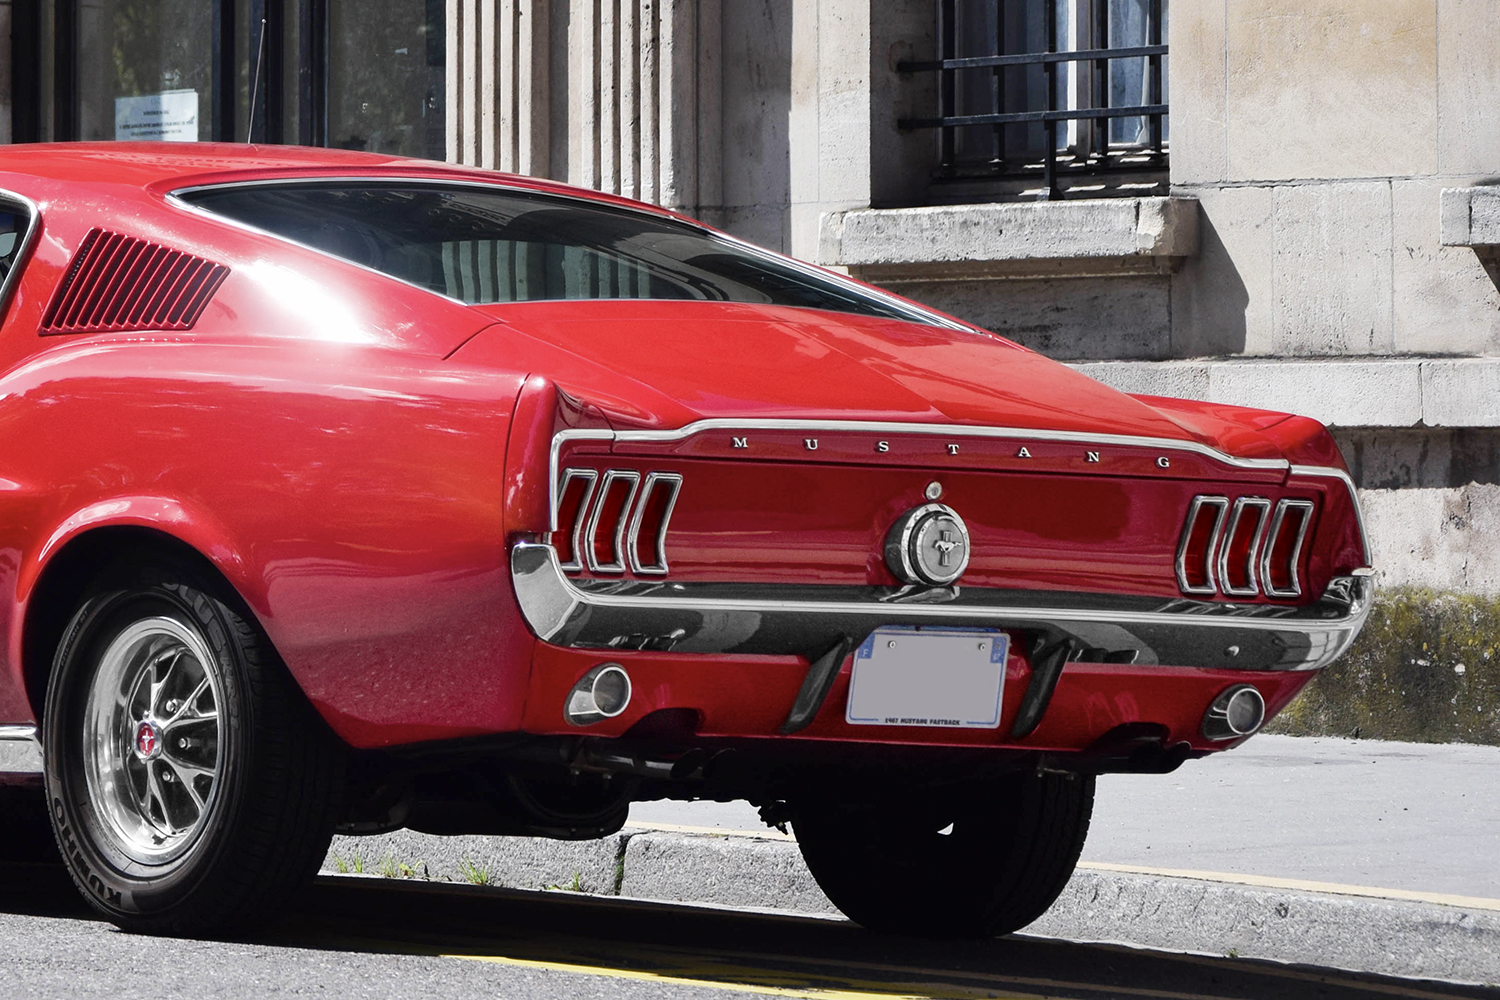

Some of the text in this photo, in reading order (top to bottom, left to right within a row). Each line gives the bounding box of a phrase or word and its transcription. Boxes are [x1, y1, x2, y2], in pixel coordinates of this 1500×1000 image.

[732, 436, 1172, 469] MUSTANG
[900, 718, 928, 726] MUSTANG
[929, 718, 961, 727] FASTBACK
[53, 796, 123, 909] KUMHO
